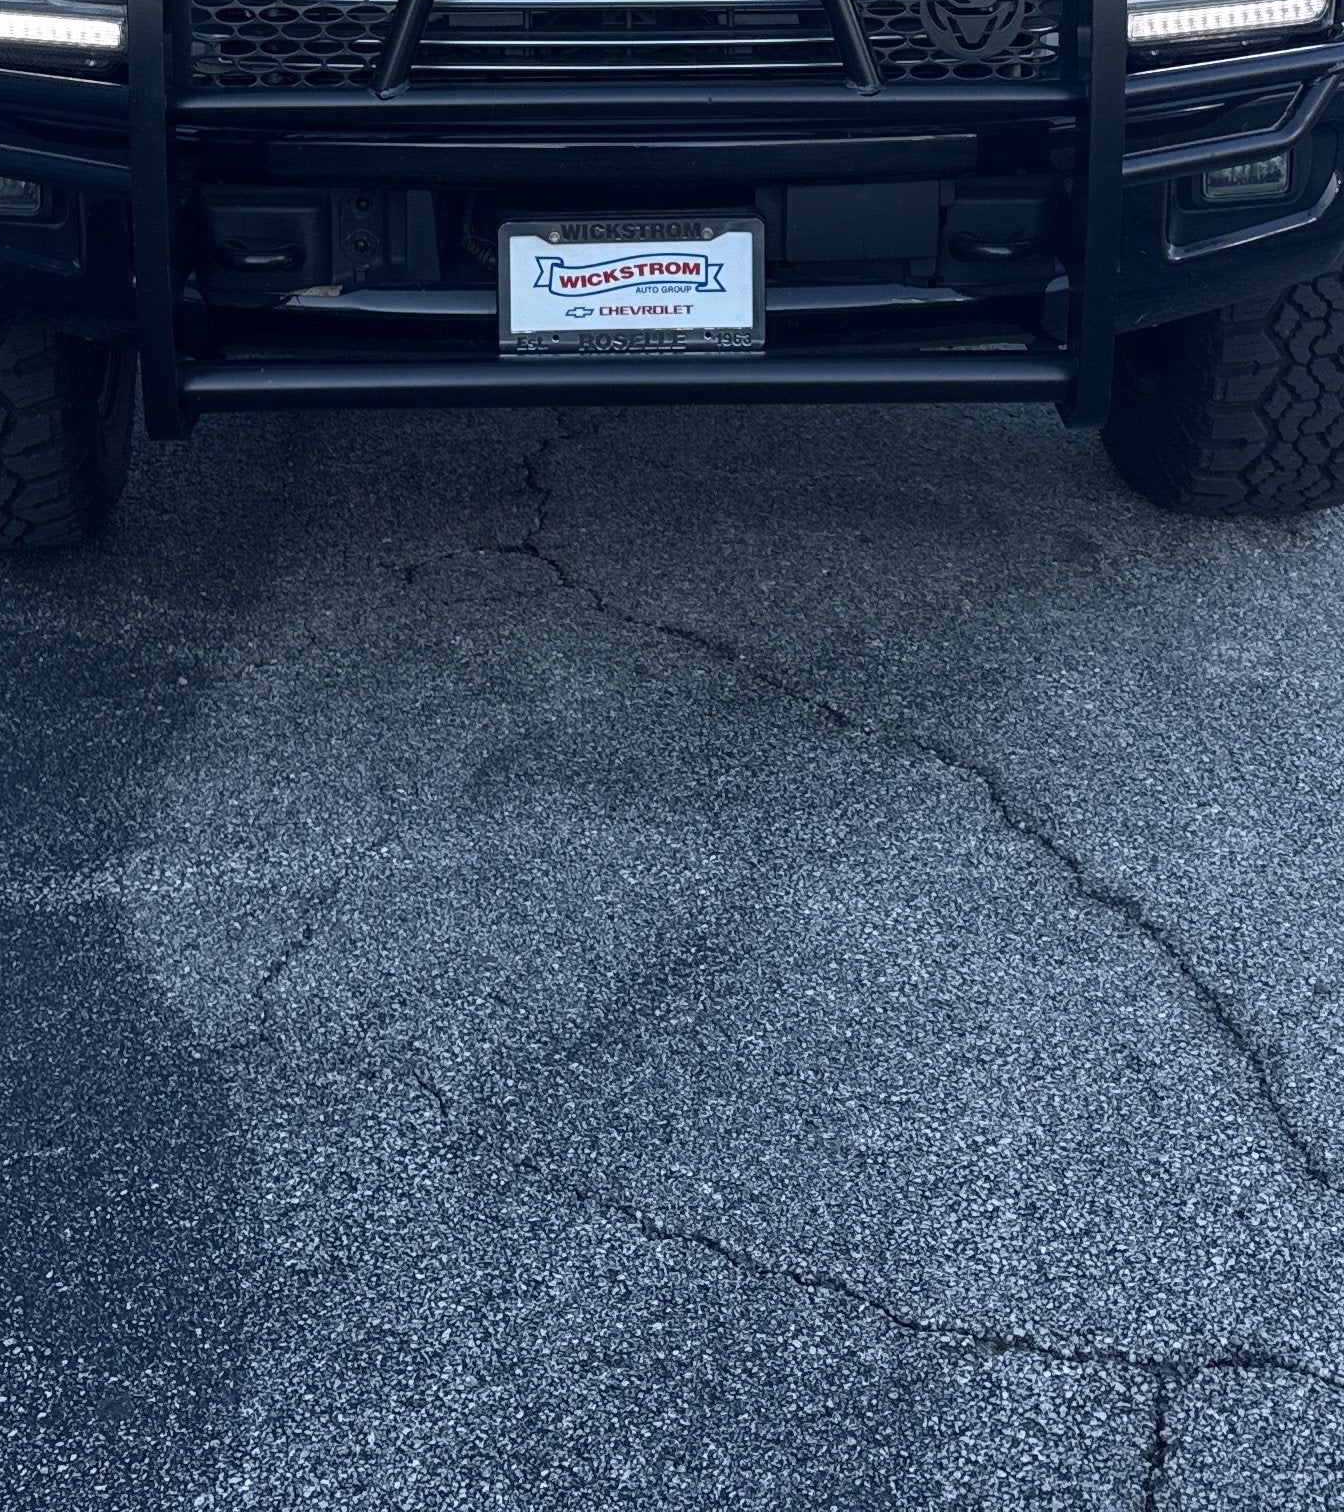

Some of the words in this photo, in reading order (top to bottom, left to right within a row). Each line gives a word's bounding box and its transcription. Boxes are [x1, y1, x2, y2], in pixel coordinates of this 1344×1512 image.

[560, 221, 703, 241] WICKSTROM
[559, 262, 701, 289] WICKSTROM
[635, 285, 659, 294] AUTO
[661, 284, 692, 294] GROUP
[599, 304, 694, 317] CHEVROLET
[579, 332, 687, 351] ROSELLE
